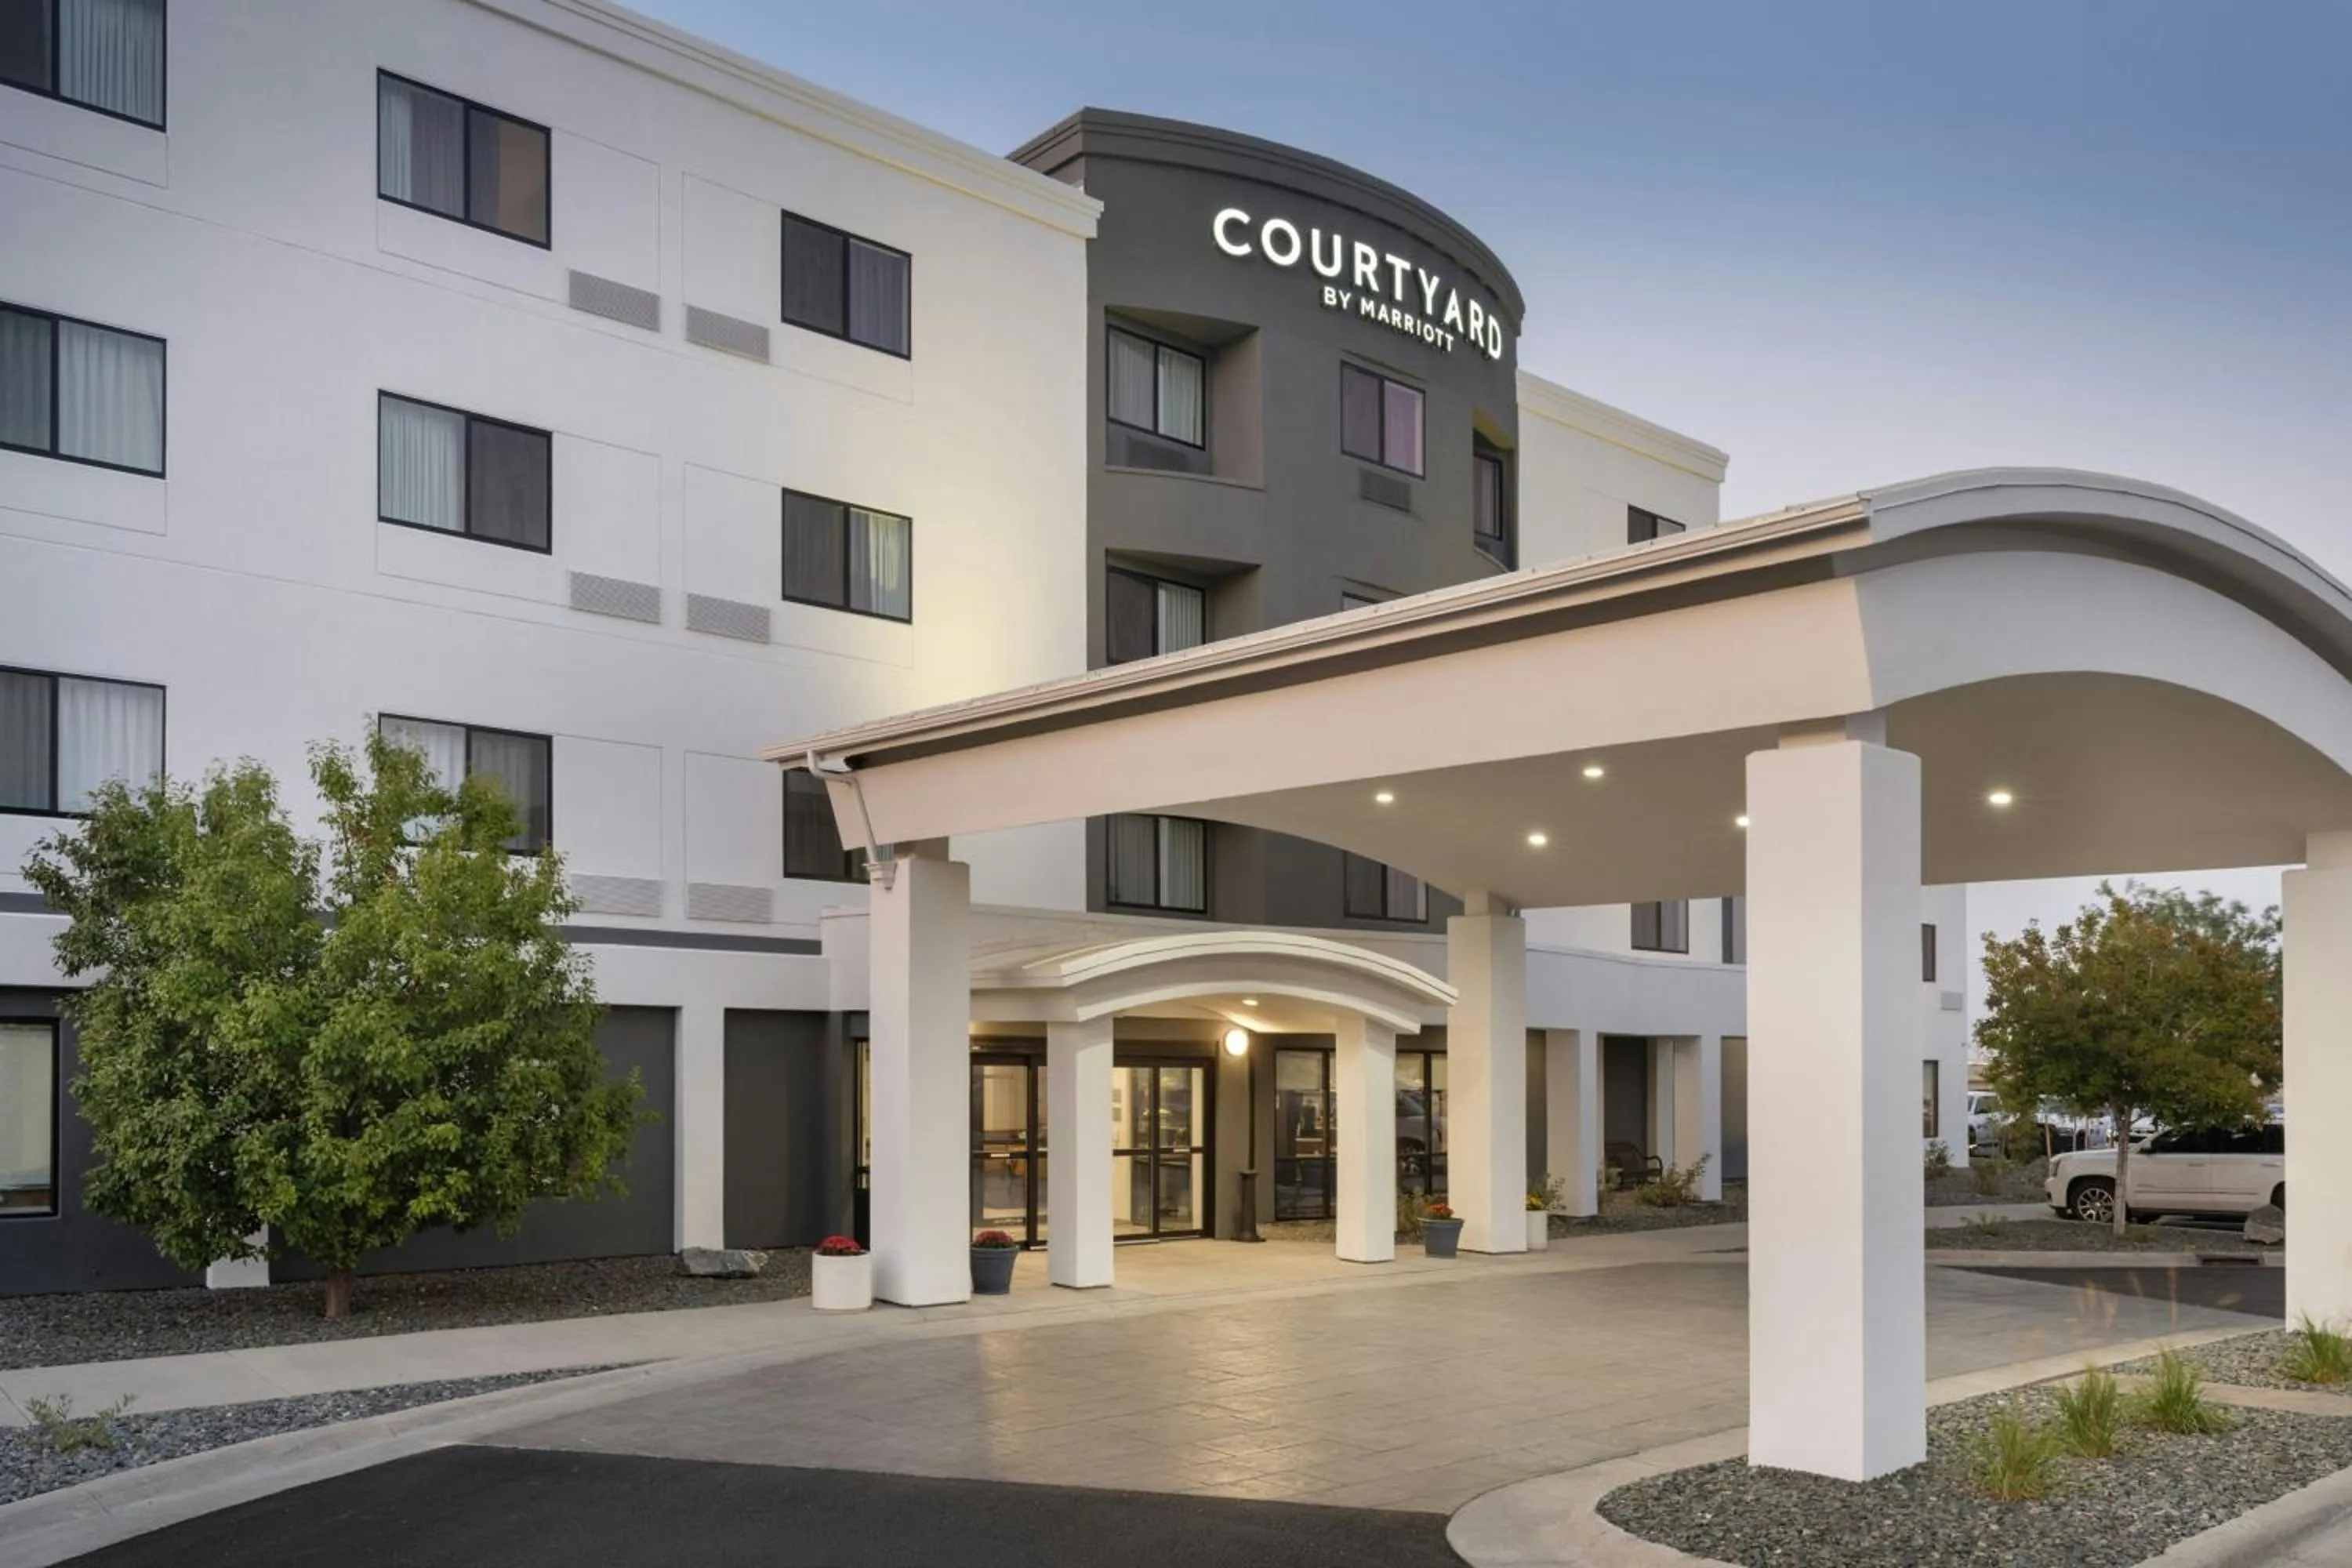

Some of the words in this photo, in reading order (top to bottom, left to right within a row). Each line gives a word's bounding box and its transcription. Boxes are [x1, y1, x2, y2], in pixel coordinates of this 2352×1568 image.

[1213, 208, 1503, 360] COURTYARD
[1323, 285, 1352, 310] BY
[1360, 297, 1454, 352] MARRIOTT
